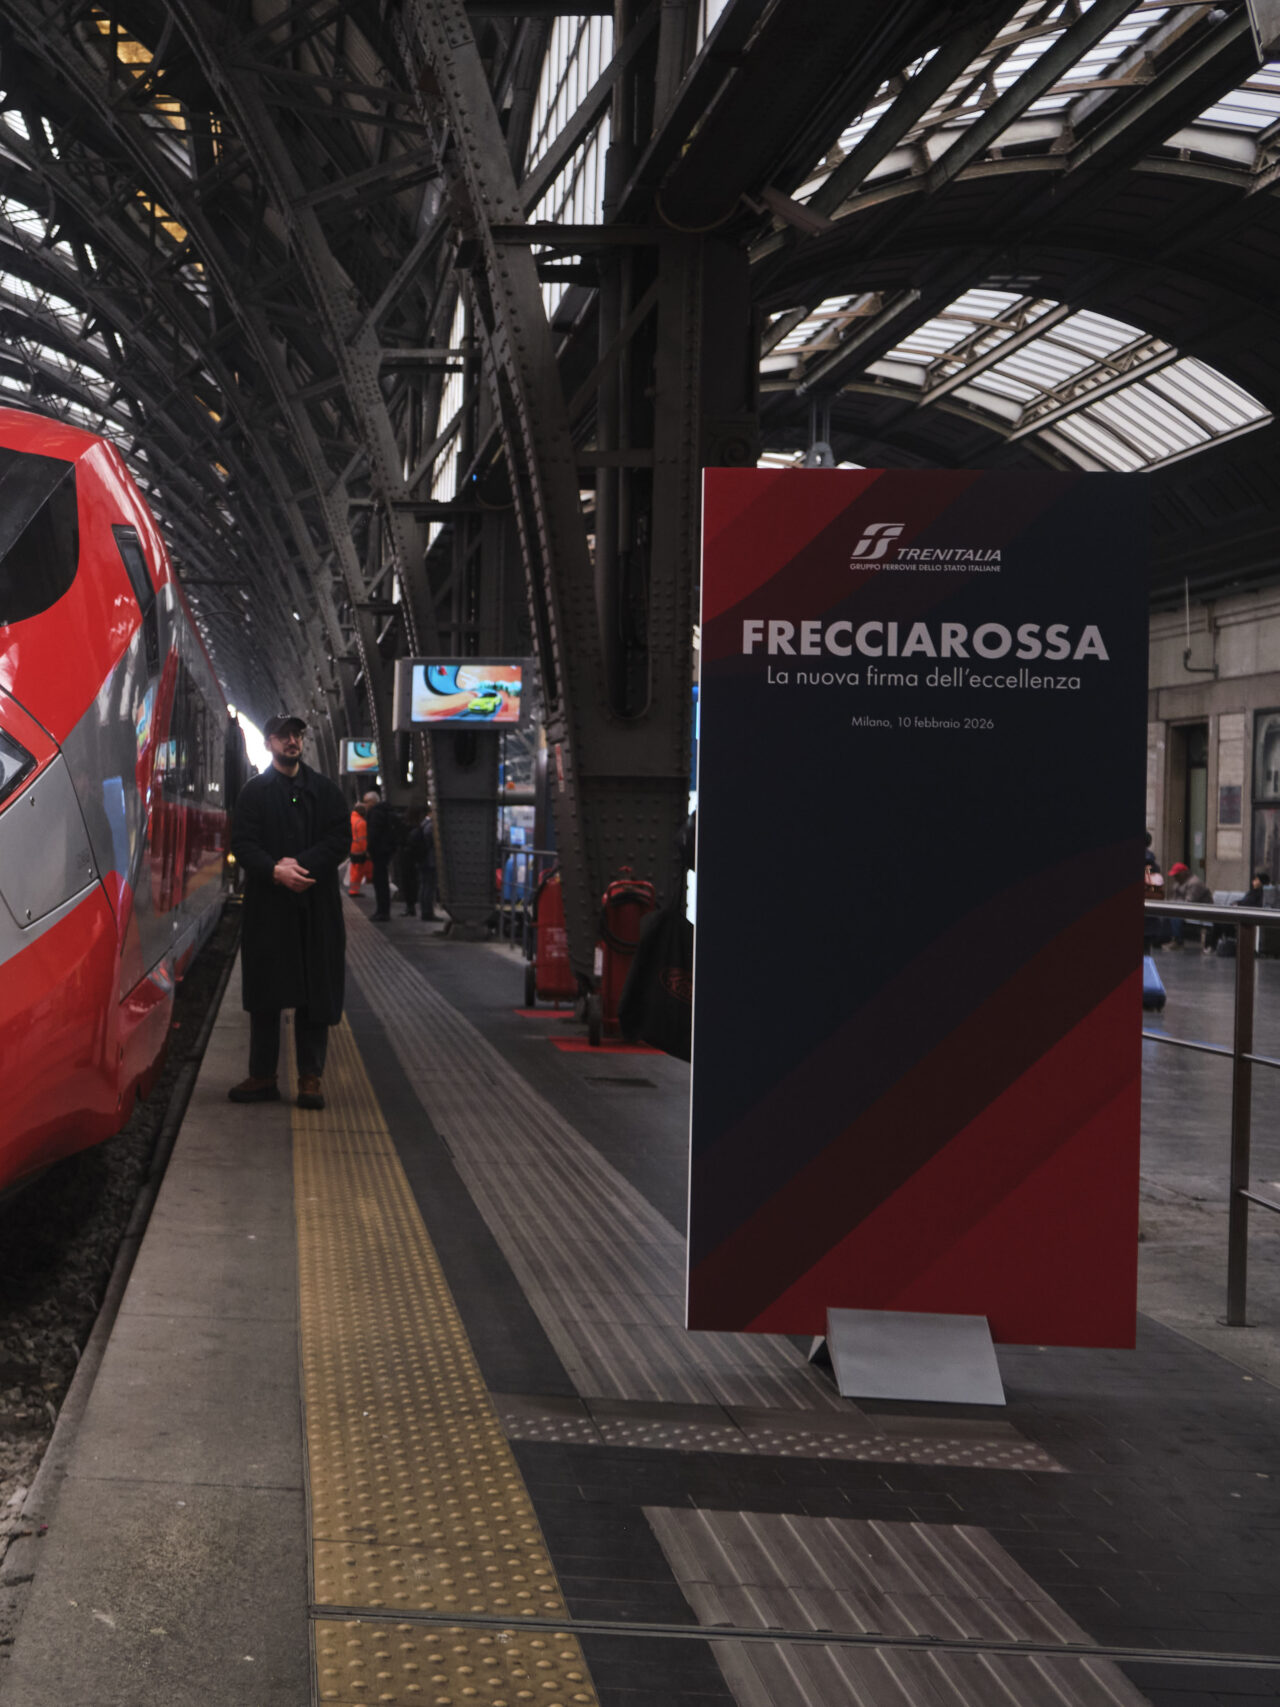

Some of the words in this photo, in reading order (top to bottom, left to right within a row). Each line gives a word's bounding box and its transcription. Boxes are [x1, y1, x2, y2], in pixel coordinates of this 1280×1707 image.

[897, 548, 1001, 562] TRENITALIA
[849, 563, 881, 571] GRUPPO
[882, 563, 917, 571] FERROVIE
[918, 564, 942, 572] DELLO
[943, 564, 966, 572] STATO
[968, 565, 1001, 573] ITALIANE
[742, 619, 1110, 661] FRECCIAROSSA
[767, 666, 789, 685] La
[797, 670, 859, 686] nuova
[866, 665, 918, 687] firma
[926, 667, 1081, 690] dell'eccellenza
[851, 715, 893, 729] Milano,
[898, 717, 911, 728] 10
[913, 715, 960, 729] febbraio
[964, 717, 994, 729] 2026
